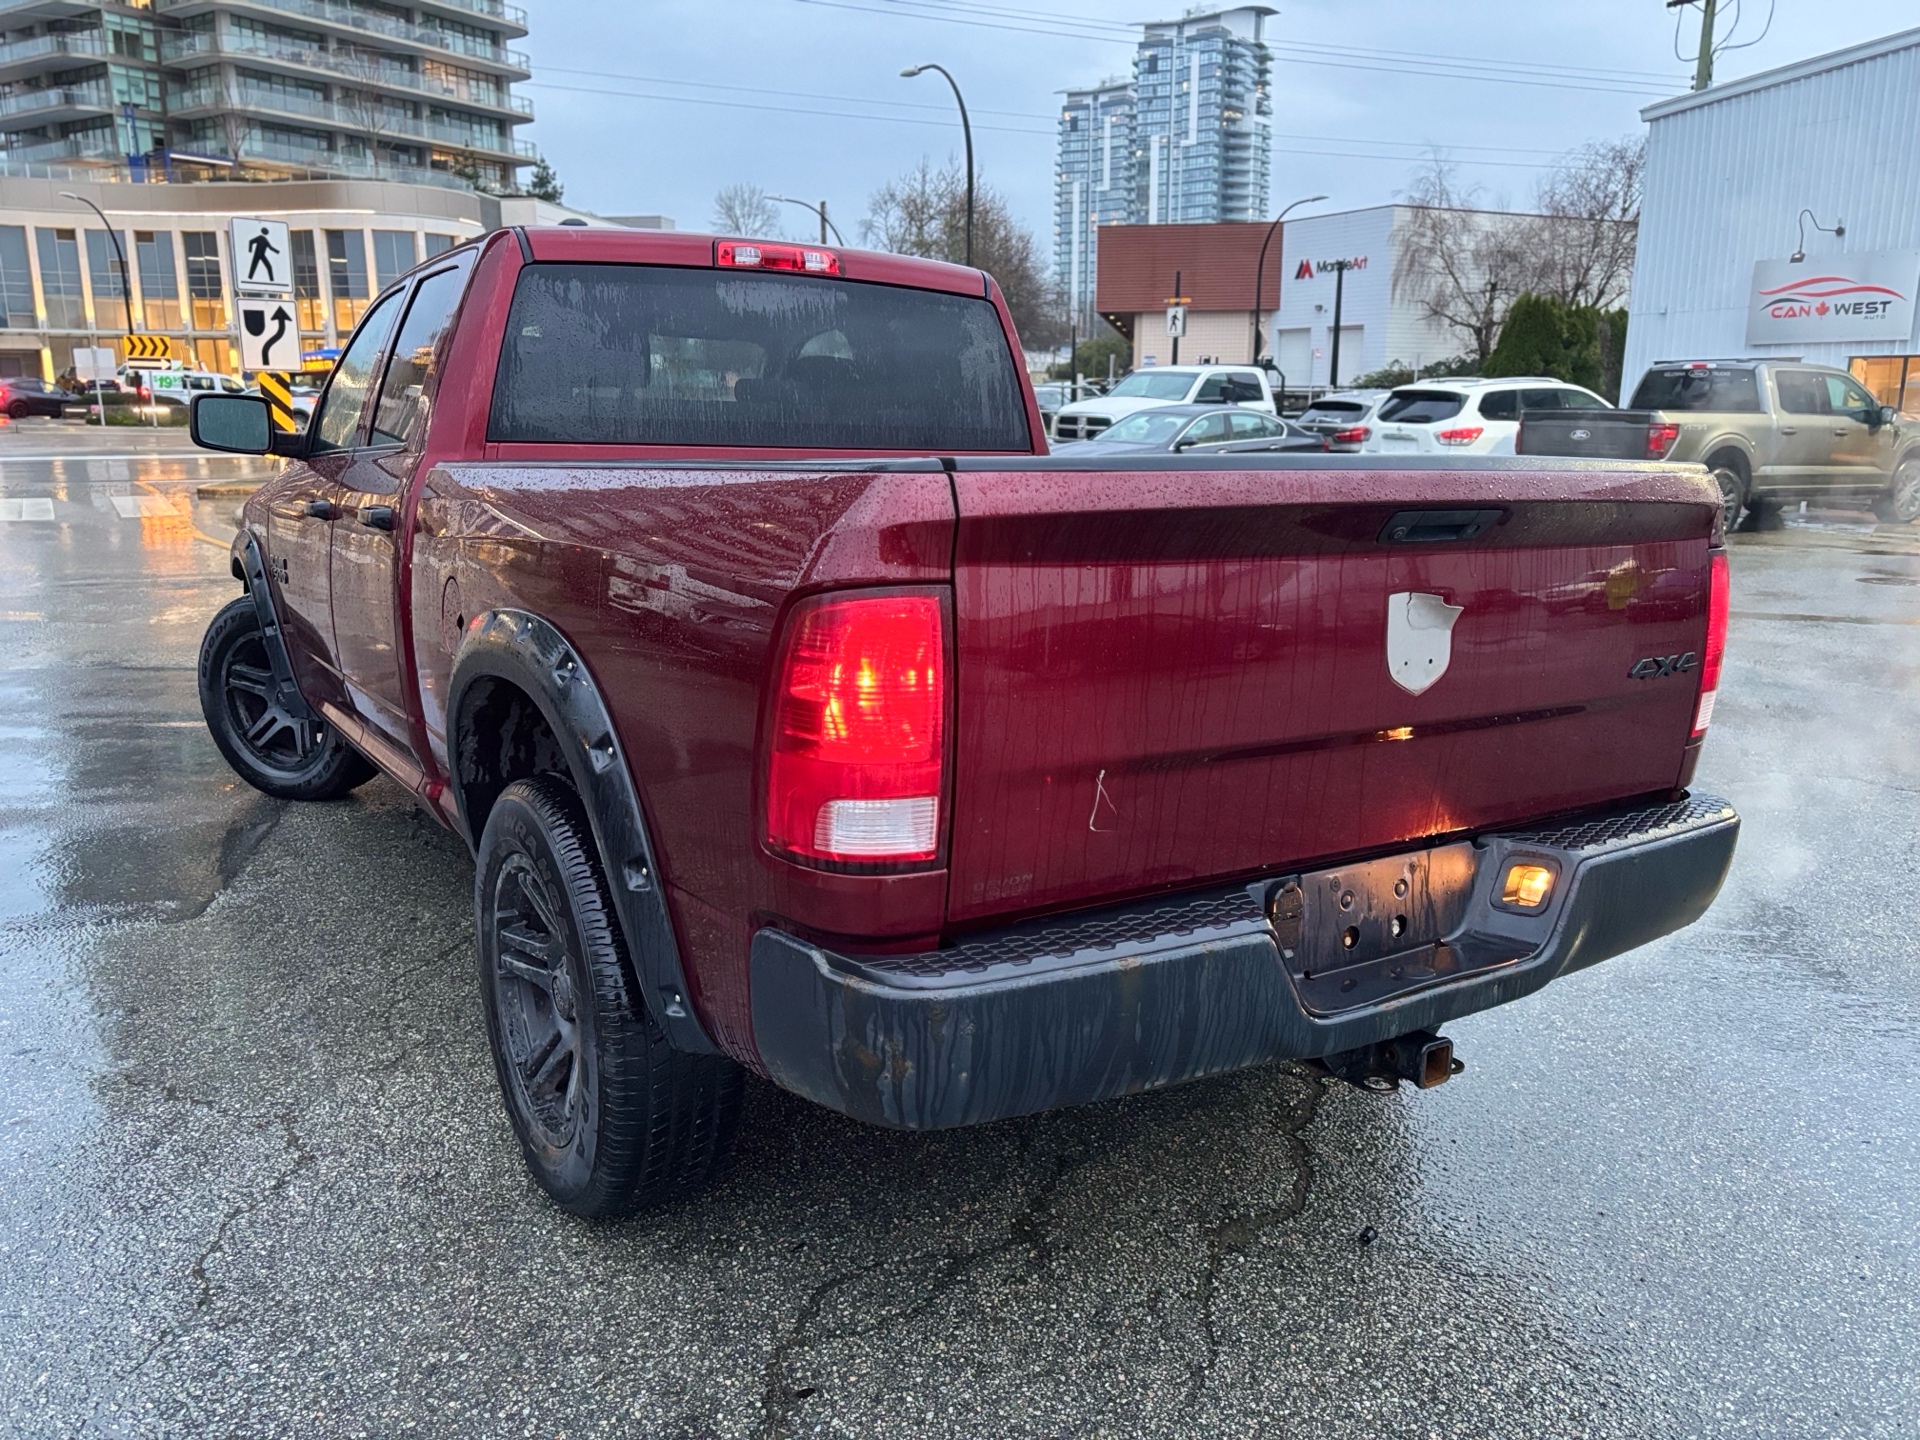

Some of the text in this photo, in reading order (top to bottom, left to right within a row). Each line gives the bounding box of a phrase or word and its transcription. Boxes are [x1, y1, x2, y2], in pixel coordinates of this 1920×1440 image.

[1317, 256, 1367, 273] MareArt
[1771, 301, 1892, 319] CAN WEST
